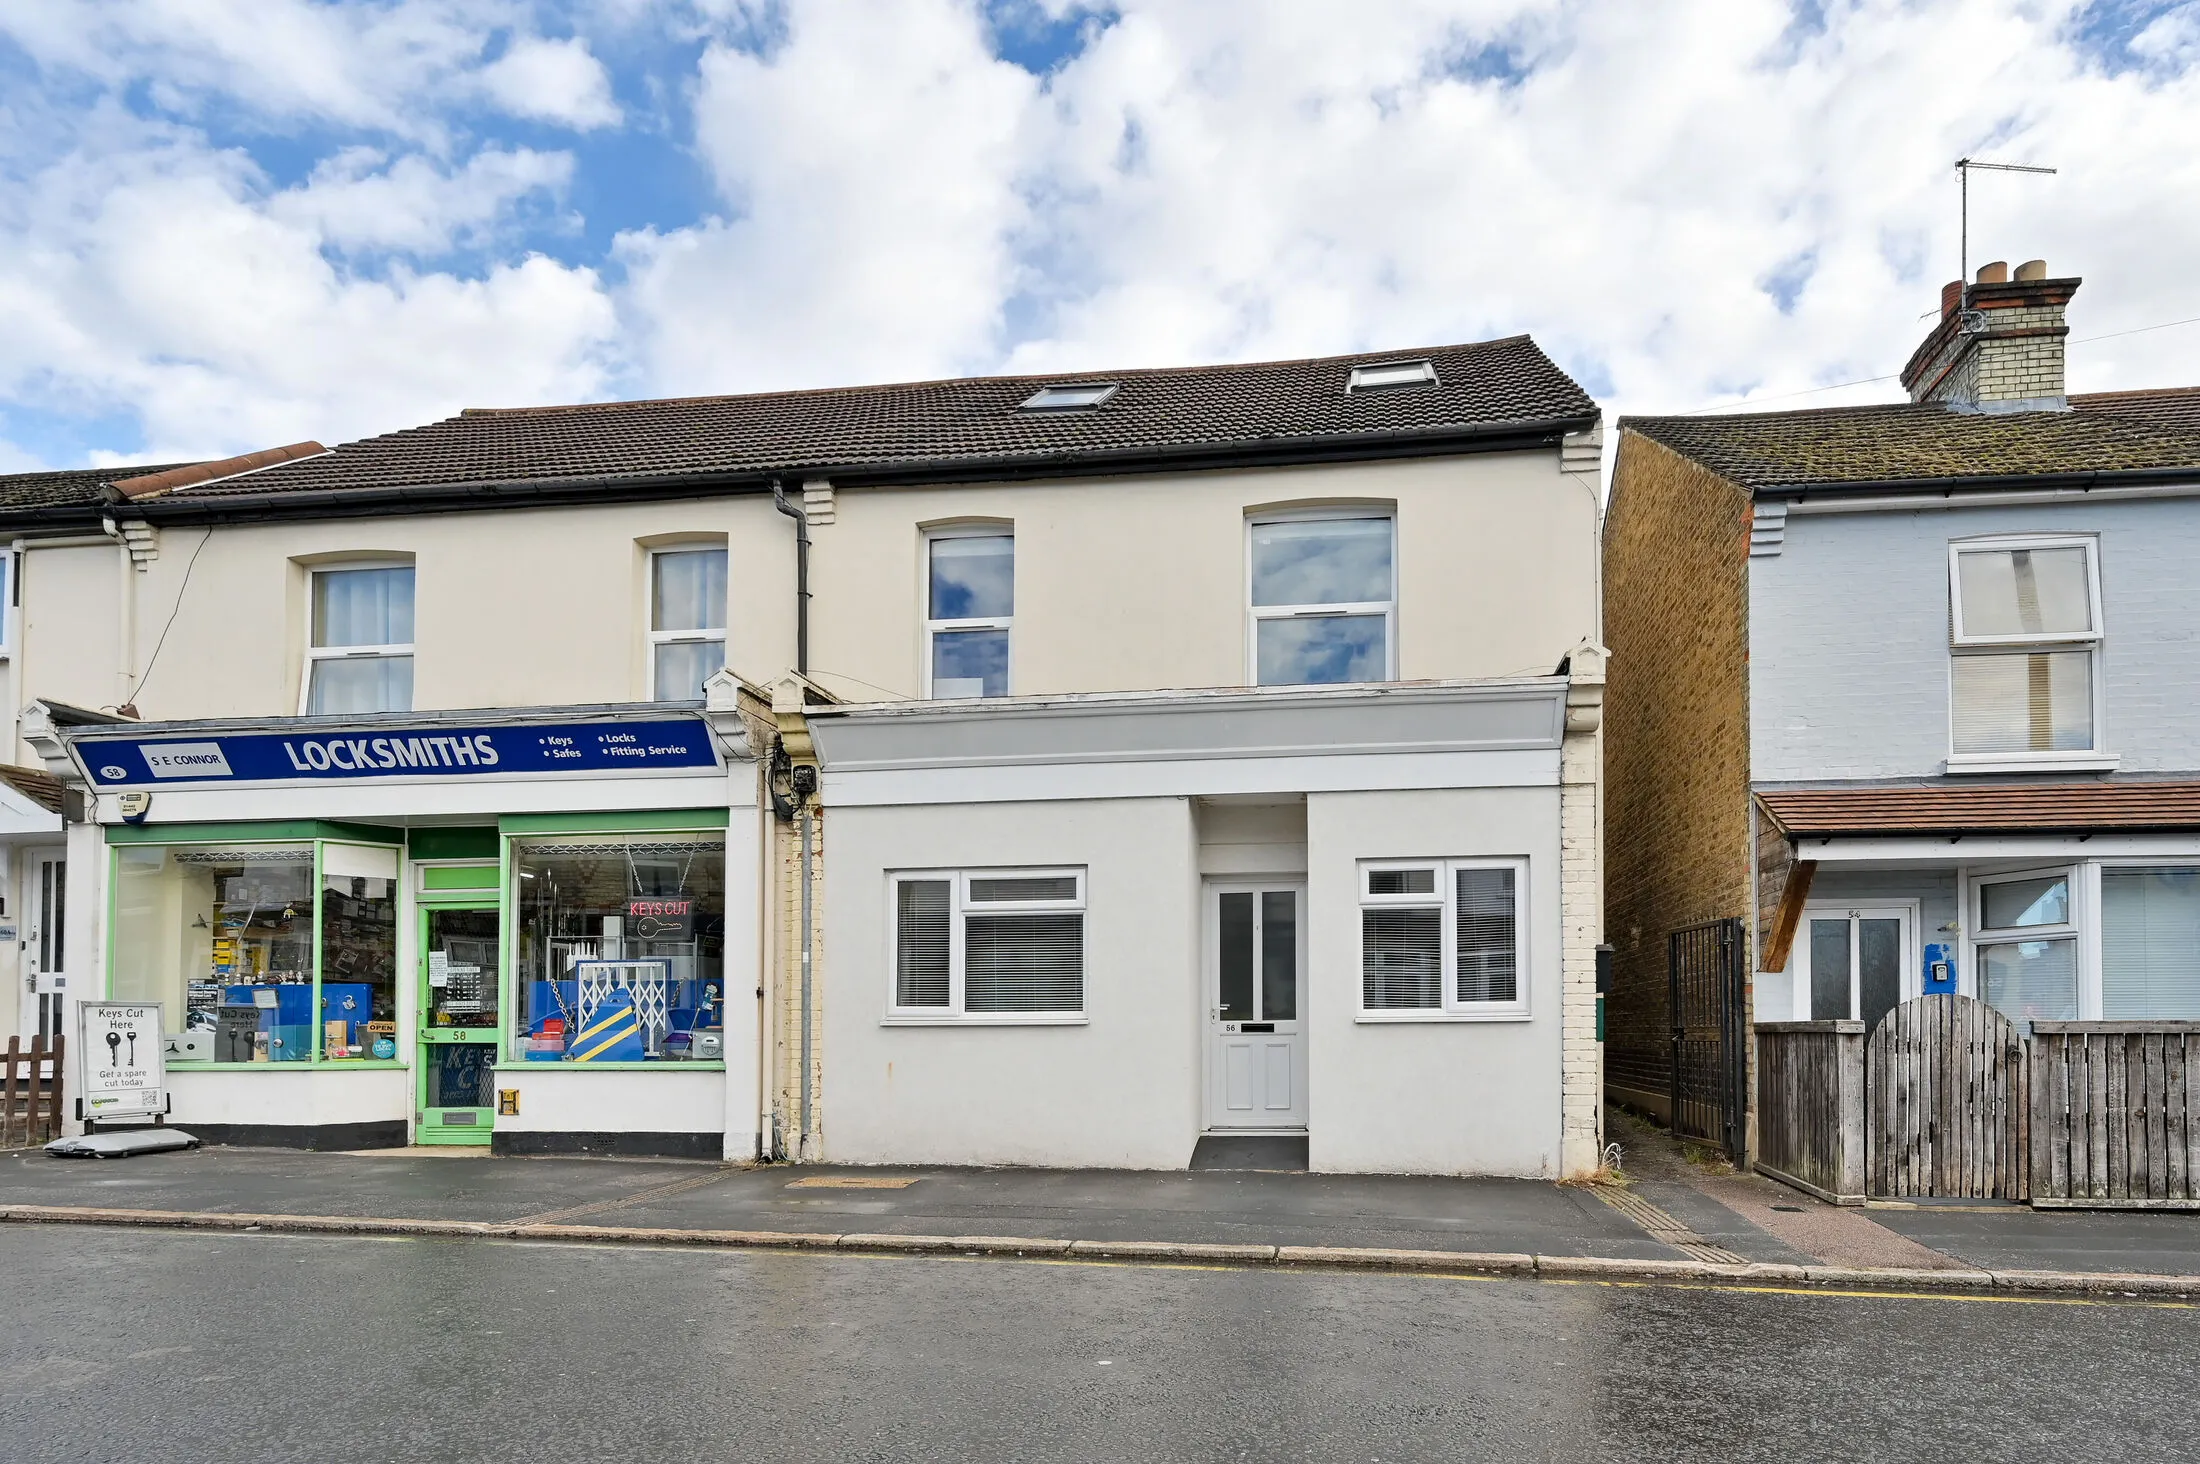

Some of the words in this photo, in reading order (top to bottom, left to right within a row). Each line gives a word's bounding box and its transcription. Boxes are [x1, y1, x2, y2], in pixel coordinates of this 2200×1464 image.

[547, 735, 573, 746] Keys
[606, 733, 636, 744] Locks
[283, 734, 499, 771] LOCKSMITHS
[552, 747, 582, 759] Safes
[610, 745, 646, 758] Fitting
[648, 744, 687, 756] Service
[151, 756, 160, 766] S
[162, 756, 171, 766] E
[174, 753, 221, 766] CONNOR
[107, 767, 120, 778] 58
[630, 902, 662, 916] KEYS
[664, 901, 690, 915] CUT
[98, 1008, 123, 1020] Keys
[126, 1008, 144, 1018] Cut
[110, 1020, 133, 1029] Here
[453, 1031, 467, 1041] 58
[99, 1070, 115, 1079] Get
[124, 1069, 147, 1080] spare
[104, 1079, 119, 1088] cut
[121, 1077, 144, 1088] today
